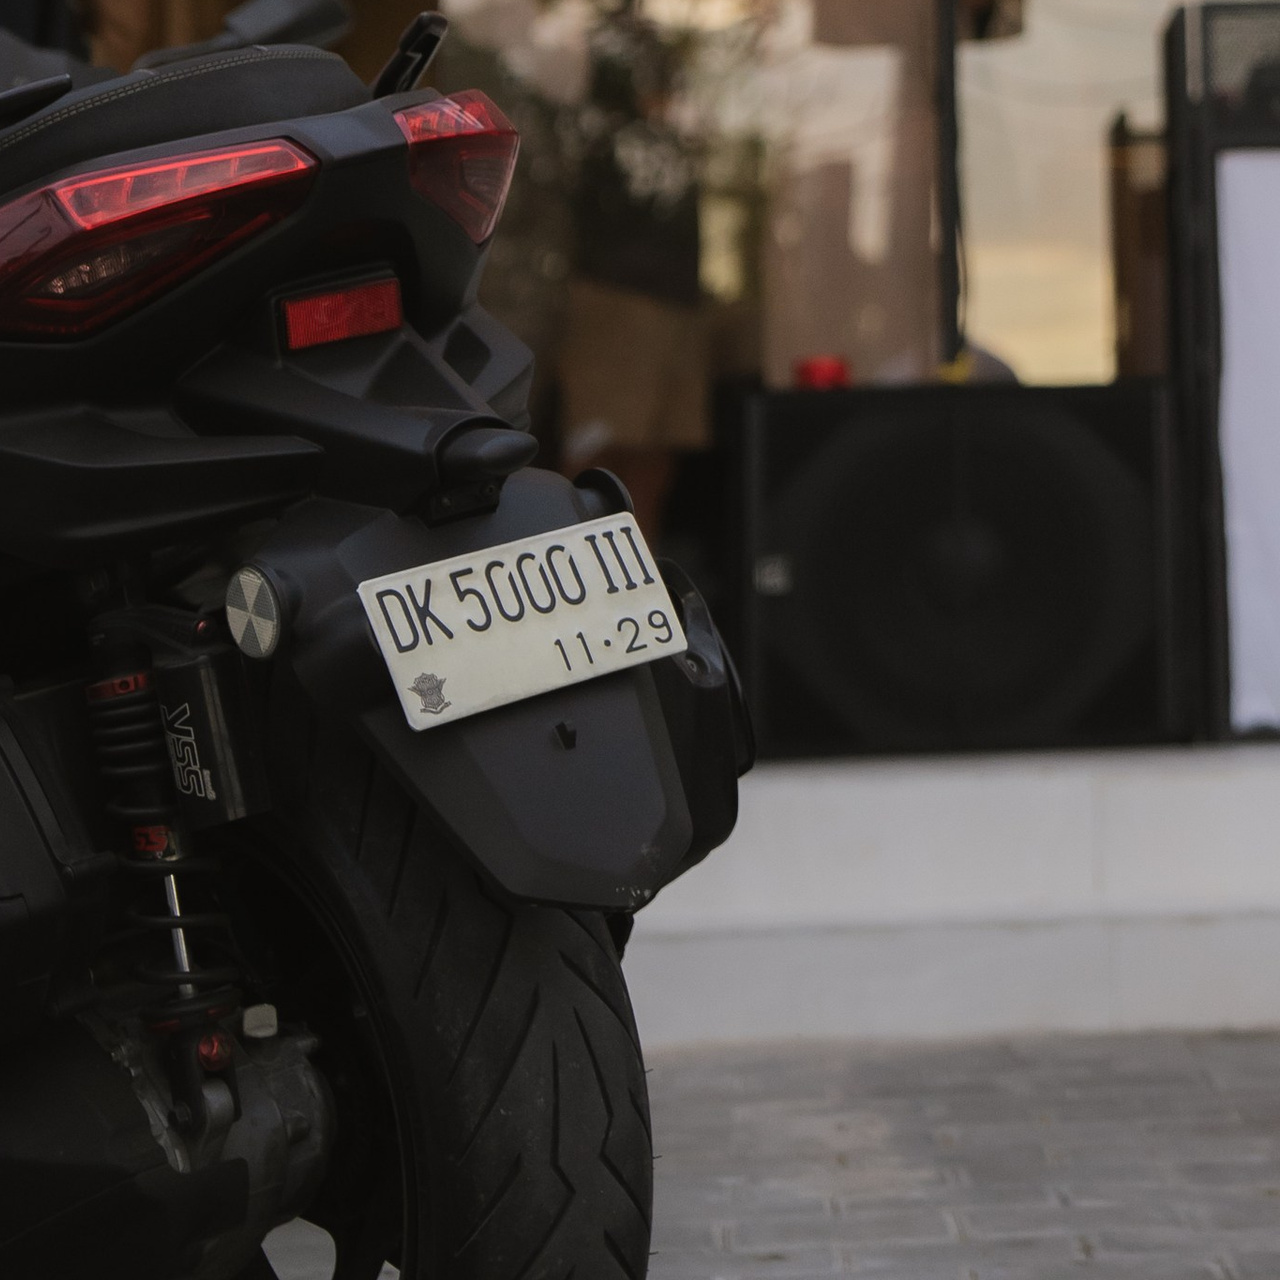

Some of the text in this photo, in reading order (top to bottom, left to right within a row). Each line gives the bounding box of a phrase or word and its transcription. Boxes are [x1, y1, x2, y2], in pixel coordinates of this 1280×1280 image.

[375, 526, 655, 654] DK 5000 III
[159, 702, 206, 797] YSS
